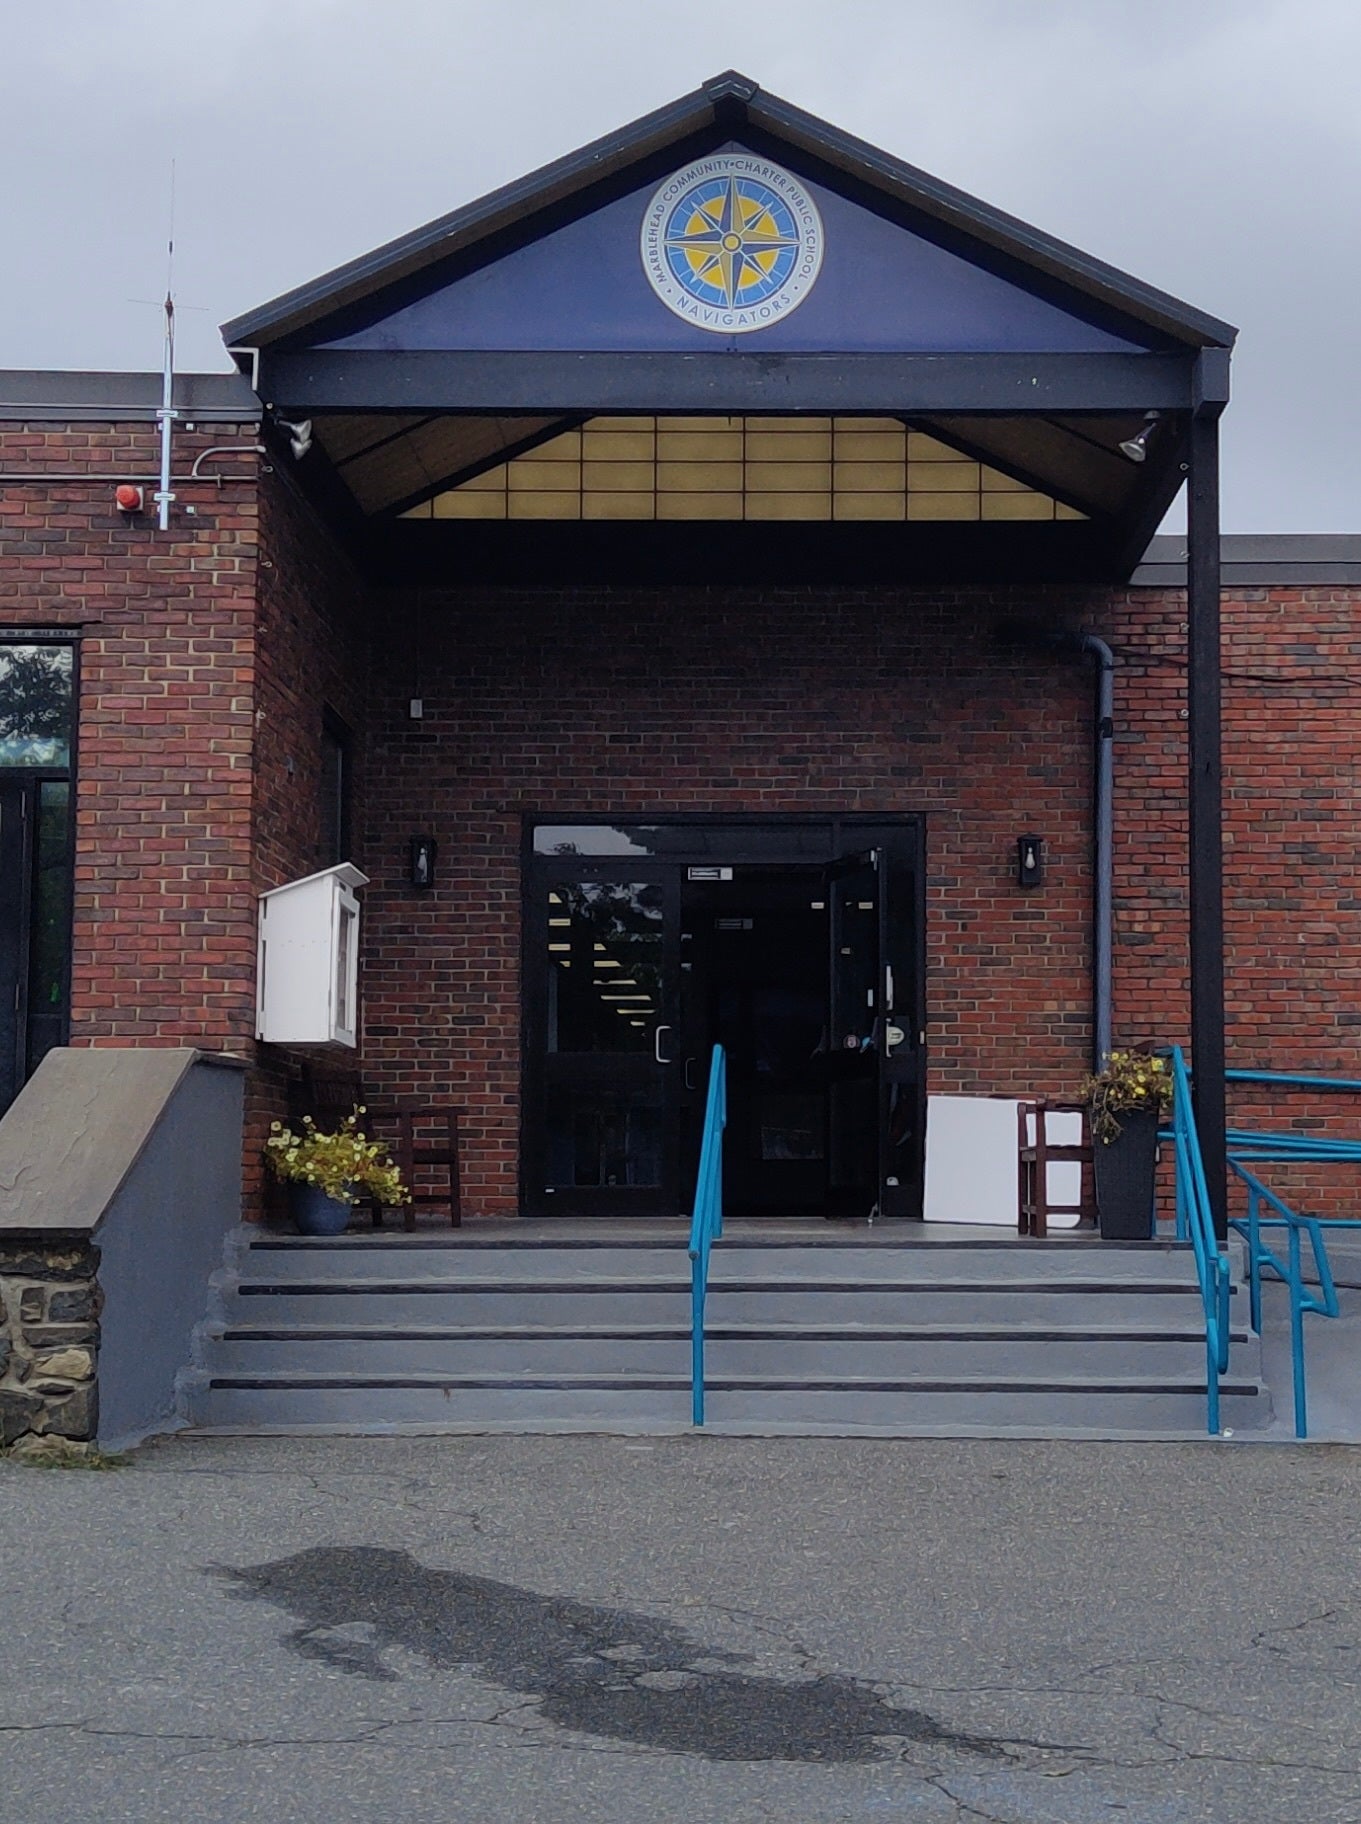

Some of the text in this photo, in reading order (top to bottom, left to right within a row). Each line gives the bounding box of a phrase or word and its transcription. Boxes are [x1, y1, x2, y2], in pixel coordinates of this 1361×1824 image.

[648, 160, 816, 284] MARBLEHEAD COMMUNITY CHARTER PUBLIC SCHOOL
[676, 293, 790, 325] NAVIGATORS
